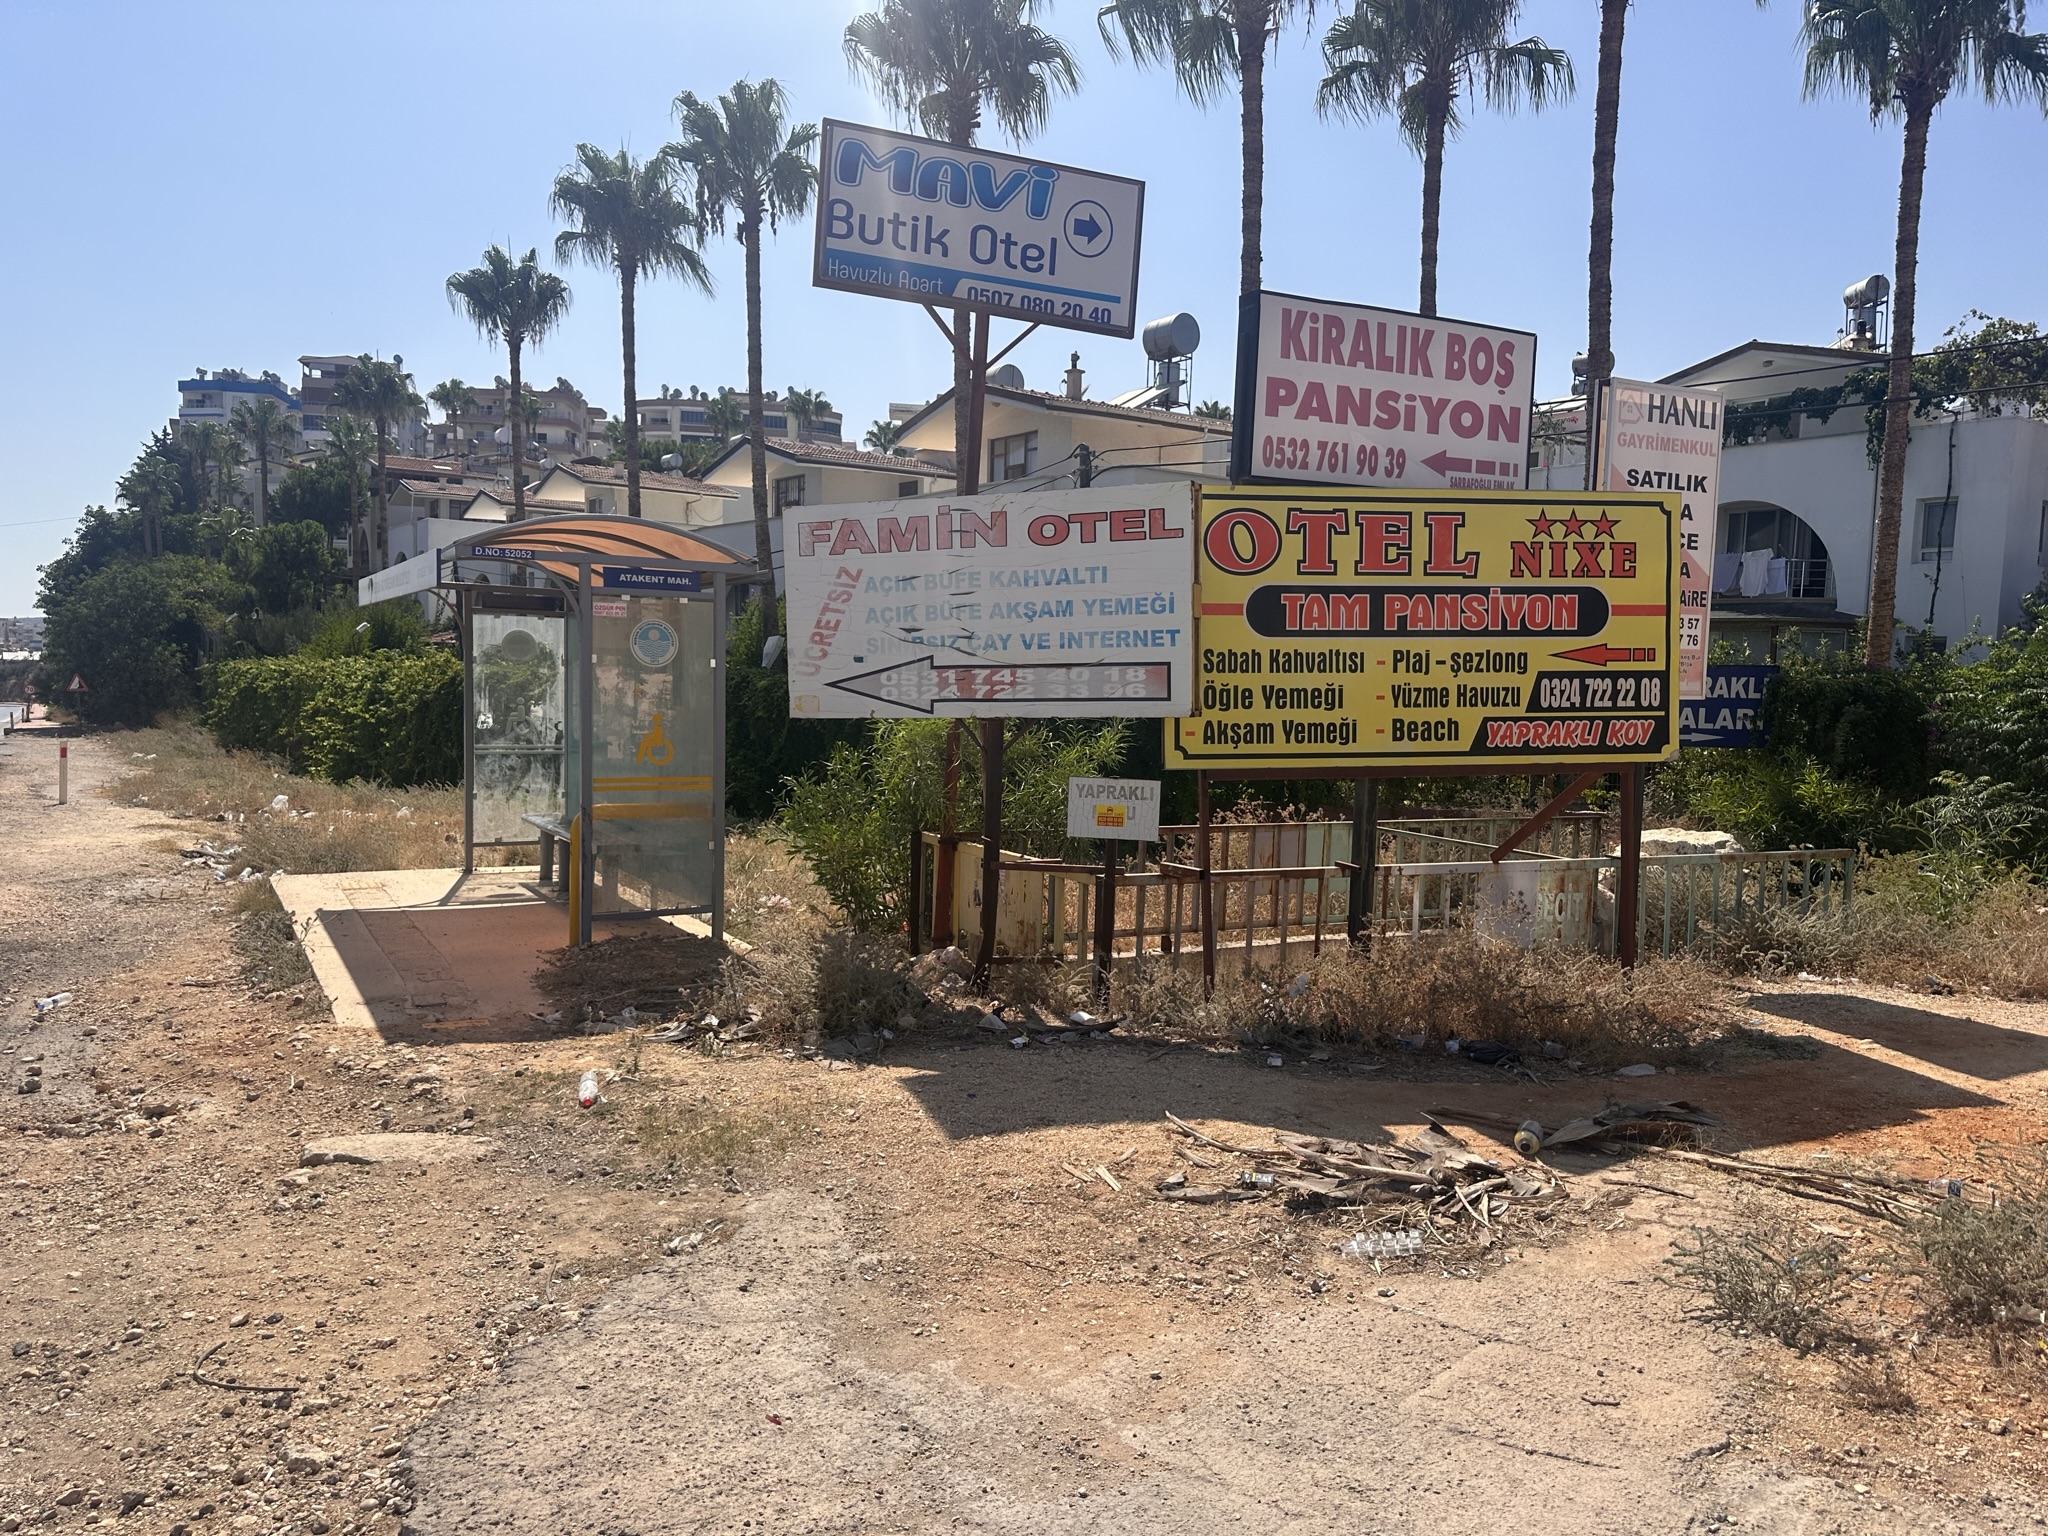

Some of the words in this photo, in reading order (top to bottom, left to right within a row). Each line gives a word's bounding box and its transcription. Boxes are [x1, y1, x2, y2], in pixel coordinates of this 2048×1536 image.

[826, 198, 949, 258] Butik
[969, 224, 1057, 276] Otel
[828, 258, 892, 286] Havuzlu
[1061, 301, 1083, 320] 20
[1089, 306, 1112, 324] 40
[1444, 332, 1515, 395] BOŞ
[1647, 393, 1717, 430] HANLI
[1262, 435, 1309, 471] 0532
[1316, 440, 1349, 473] 761
[1356, 444, 1379, 477] 90
[1384, 446, 1406, 479] 39
[1617, 431, 1717, 457] GAYRİMENKUL
[1626, 468, 1708, 493] SATILIK
[797, 504, 1008, 556] FAMİN
[1028, 508, 1184, 546] OTEL
[1203, 507, 1481, 579] OTEL
[1510, 540, 1637, 578] NIXE
[475, 547, 503, 557] D.NO:
[504, 548, 532, 559] 52052
[618, 573, 665, 584] ATAKENT
[667, 575, 692, 585] MAH.
[864, 575, 917, 597] AÇIK
[923, 568, 982, 590] BÜFE
[989, 565, 1108, 588] KAHVALTI
[865, 604, 918, 627] AÇIK
[924, 600, 982, 623] BÜFE
[989, 599, 1074, 623] AKŞAM
[1082, 592, 1176, 617] YEMEĞİ
[1279, 593, 1370, 631] TAM
[1383, 587, 1578, 631] PANSİYON
[1687, 617, 1700, 630] 57
[1019, 632, 1051, 651] VE
[1686, 634, 1699, 647] 76
[1203, 648, 1262, 674] Sabah
[1269, 648, 1365, 674] Kahvaltısı
[1392, 649, 1430, 675] Plaj
[1450, 649, 1528, 677] şezlong
[880, 669, 961, 686] 0531
[971, 668, 1035, 684] 745
[1104, 667, 1147, 683] 18
[973, 685, 1036, 700] 722
[1203, 680, 1254, 711] Öğle
[1261, 682, 1344, 711] Yemeği
[1391, 682, 1449, 708] Yüzme
[1456, 684, 1521, 707] Havuzu
[1539, 678, 1580, 708] 0324
[1584, 679, 1612, 708] 722
[1616, 679, 1637, 708] 22
[1640, 679, 1661, 708] 08
[1203, 720, 1275, 748] Akşam
[1281, 717, 1357, 744] Yemeği
[1391, 717, 1460, 742] Beach
[1486, 721, 1601, 748] YAPRAKLI
[1605, 720, 1656, 747] KOY
[1075, 783, 1155, 801] YAPRAKLI
